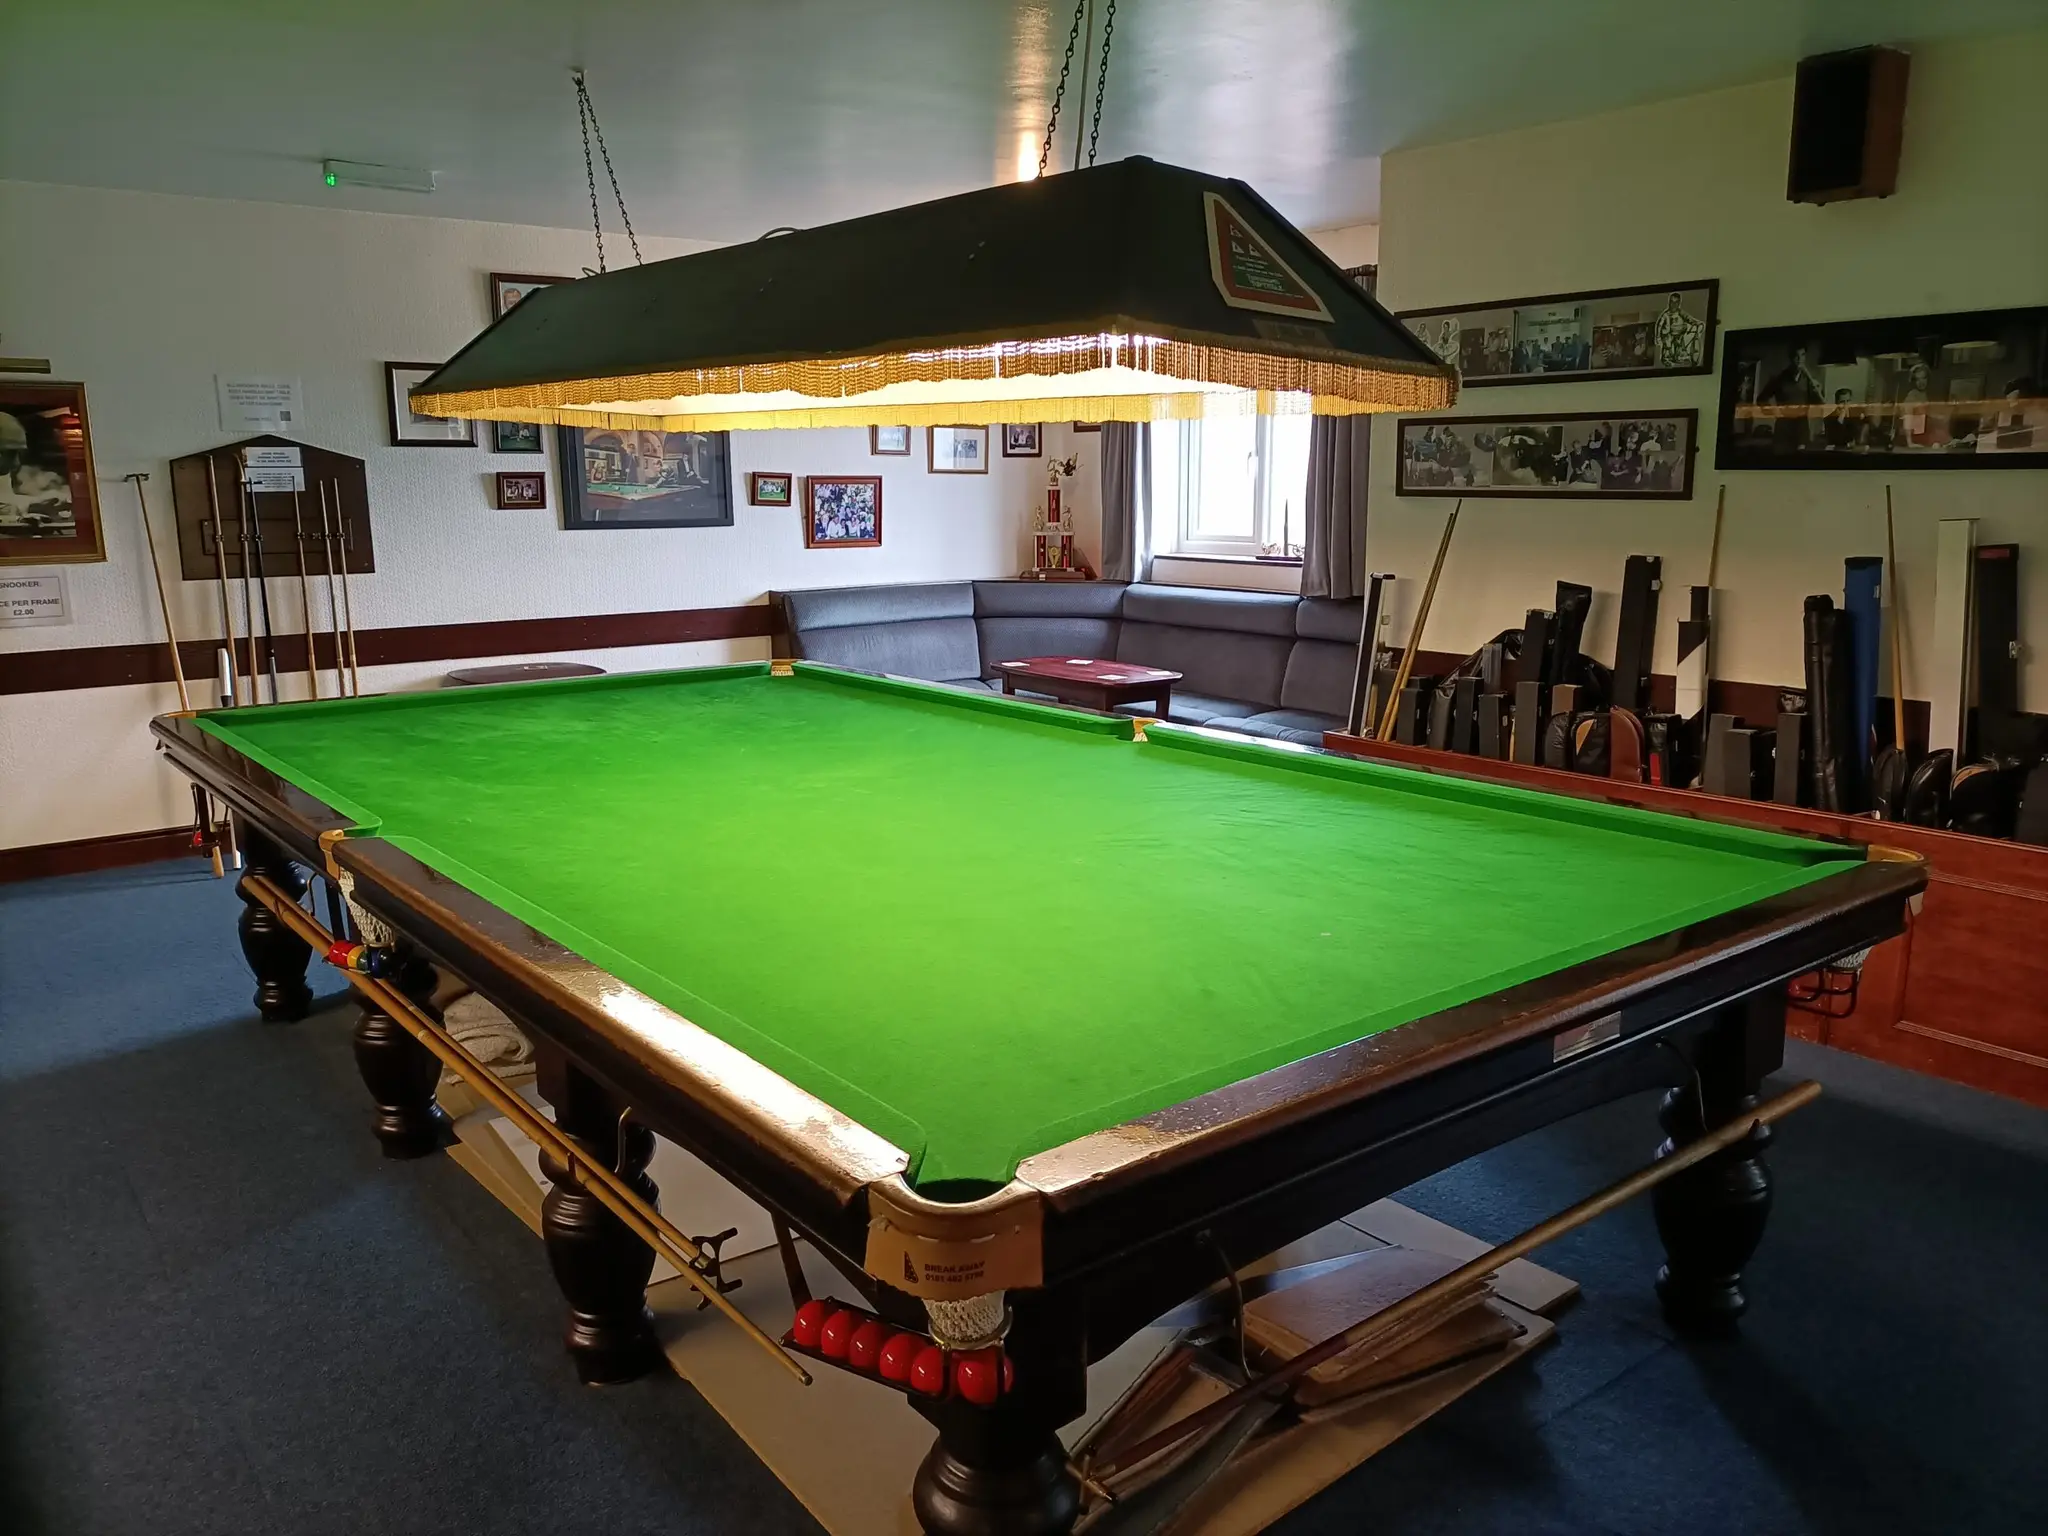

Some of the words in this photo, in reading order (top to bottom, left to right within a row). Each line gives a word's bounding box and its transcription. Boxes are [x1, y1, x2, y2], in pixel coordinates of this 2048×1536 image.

[13, 608, 35, 616] £2.00
[924, 1264, 956, 1272] BREAK
[958, 1261, 985, 1272] AWAY
